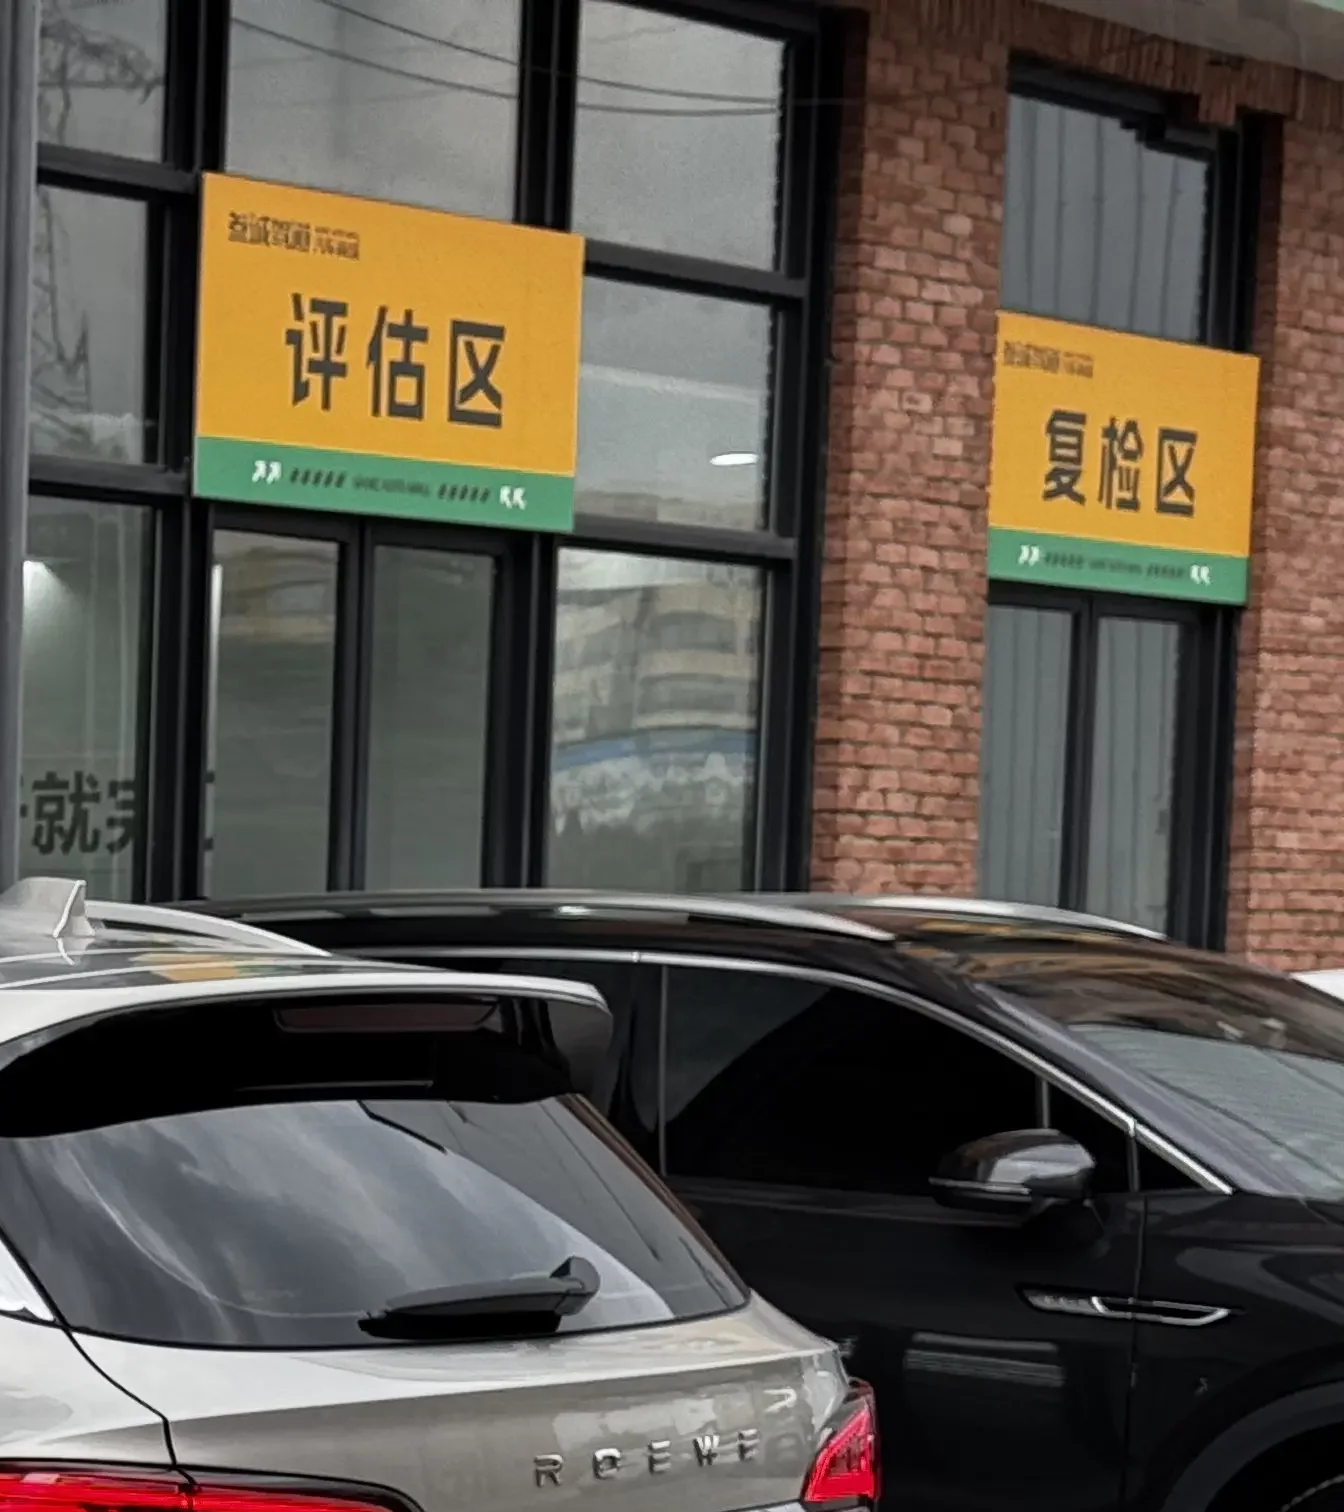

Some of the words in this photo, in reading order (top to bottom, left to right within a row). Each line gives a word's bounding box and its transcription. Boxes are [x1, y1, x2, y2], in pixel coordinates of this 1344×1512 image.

[285, 292, 506, 429] 评估区
[1042, 408, 1198, 518] 复检区
[533, 1428, 761, 1489] ROEWE
